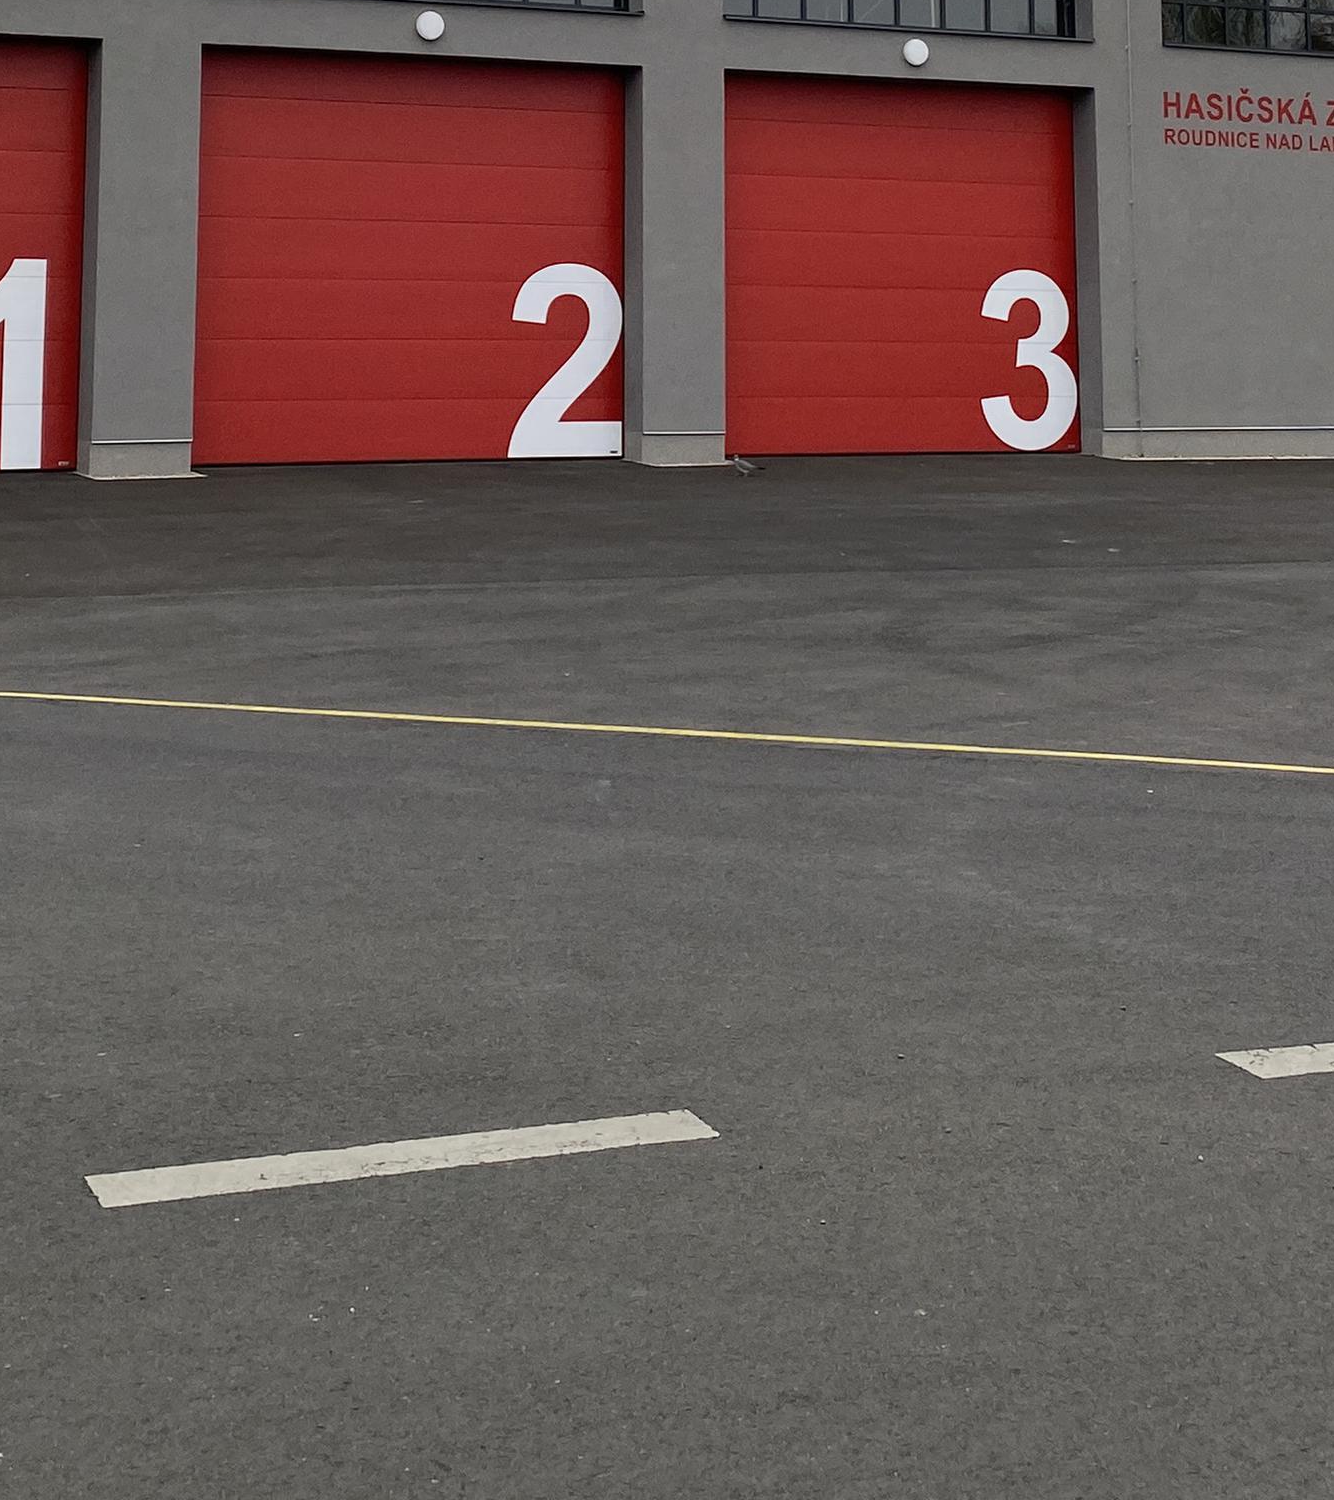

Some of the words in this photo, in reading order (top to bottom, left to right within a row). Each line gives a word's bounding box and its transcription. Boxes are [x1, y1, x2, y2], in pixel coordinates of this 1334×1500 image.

[1162, 87, 1318, 127] HASIČSKÁ
[1163, 128, 1260, 149] ROUDNICE
[1265, 133, 1304, 150] NAD
[507, 262, 623, 459] 2
[980, 268, 1078, 452] 3
